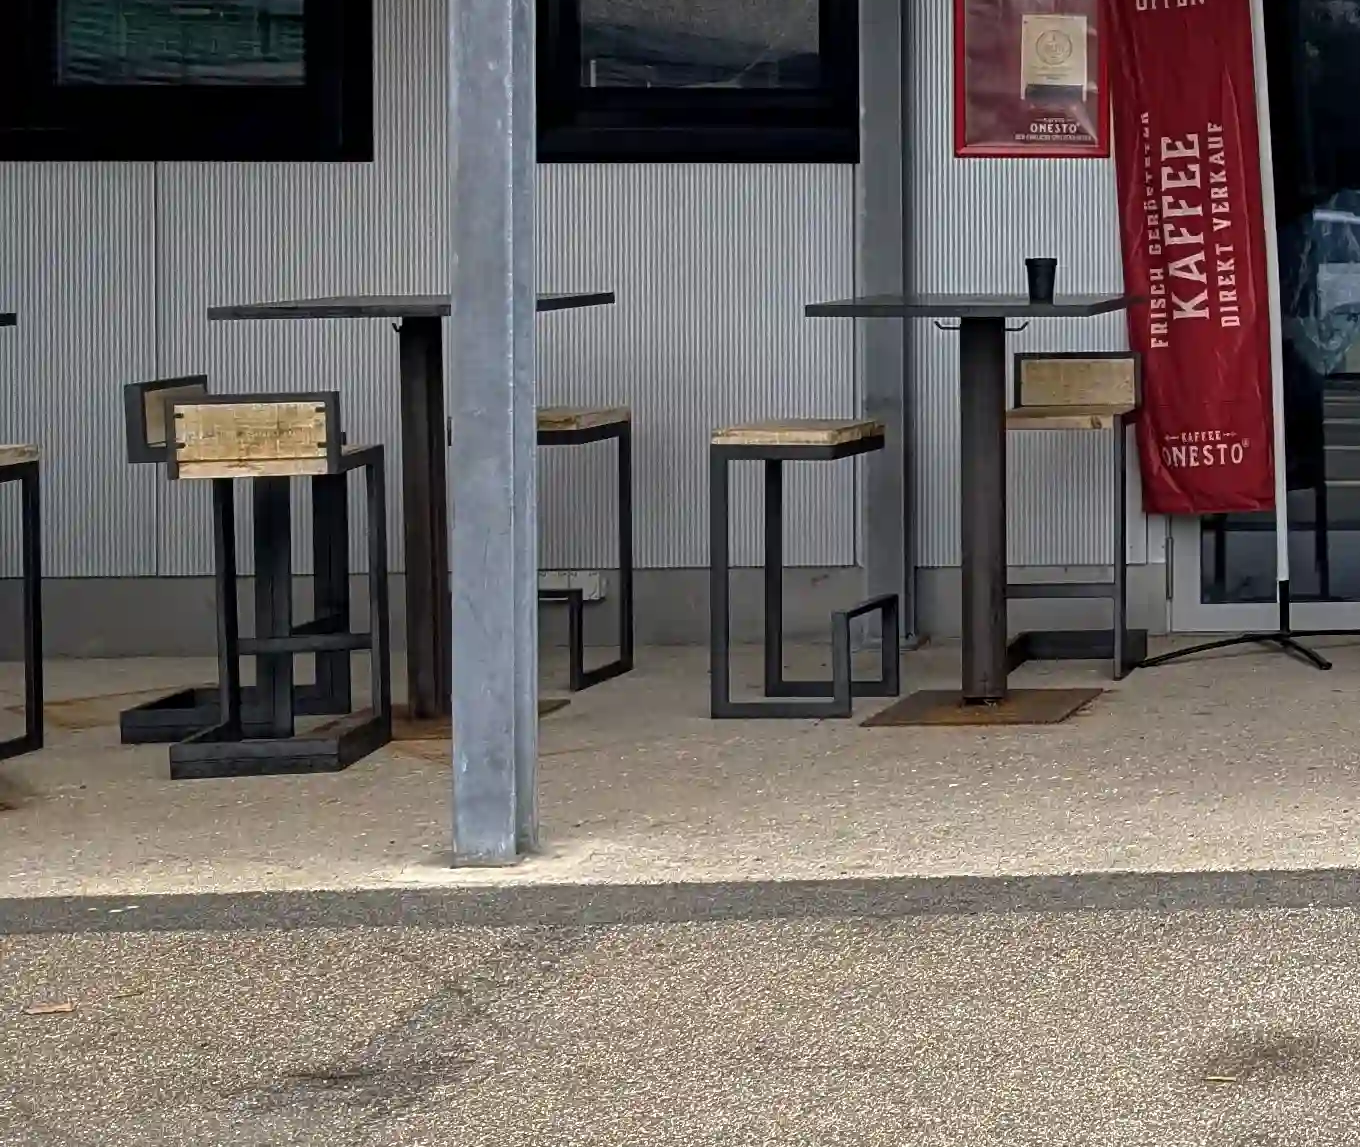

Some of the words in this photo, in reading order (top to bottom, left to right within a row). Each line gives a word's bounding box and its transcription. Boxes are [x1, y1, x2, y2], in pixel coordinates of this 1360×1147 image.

[1207, 122, 1232, 232] VERKAUF
[1160, 133, 1210, 320] KAFFEE
[1150, 268, 1169, 349] FRISCH
[1215, 243, 1241, 328] DIREKT
